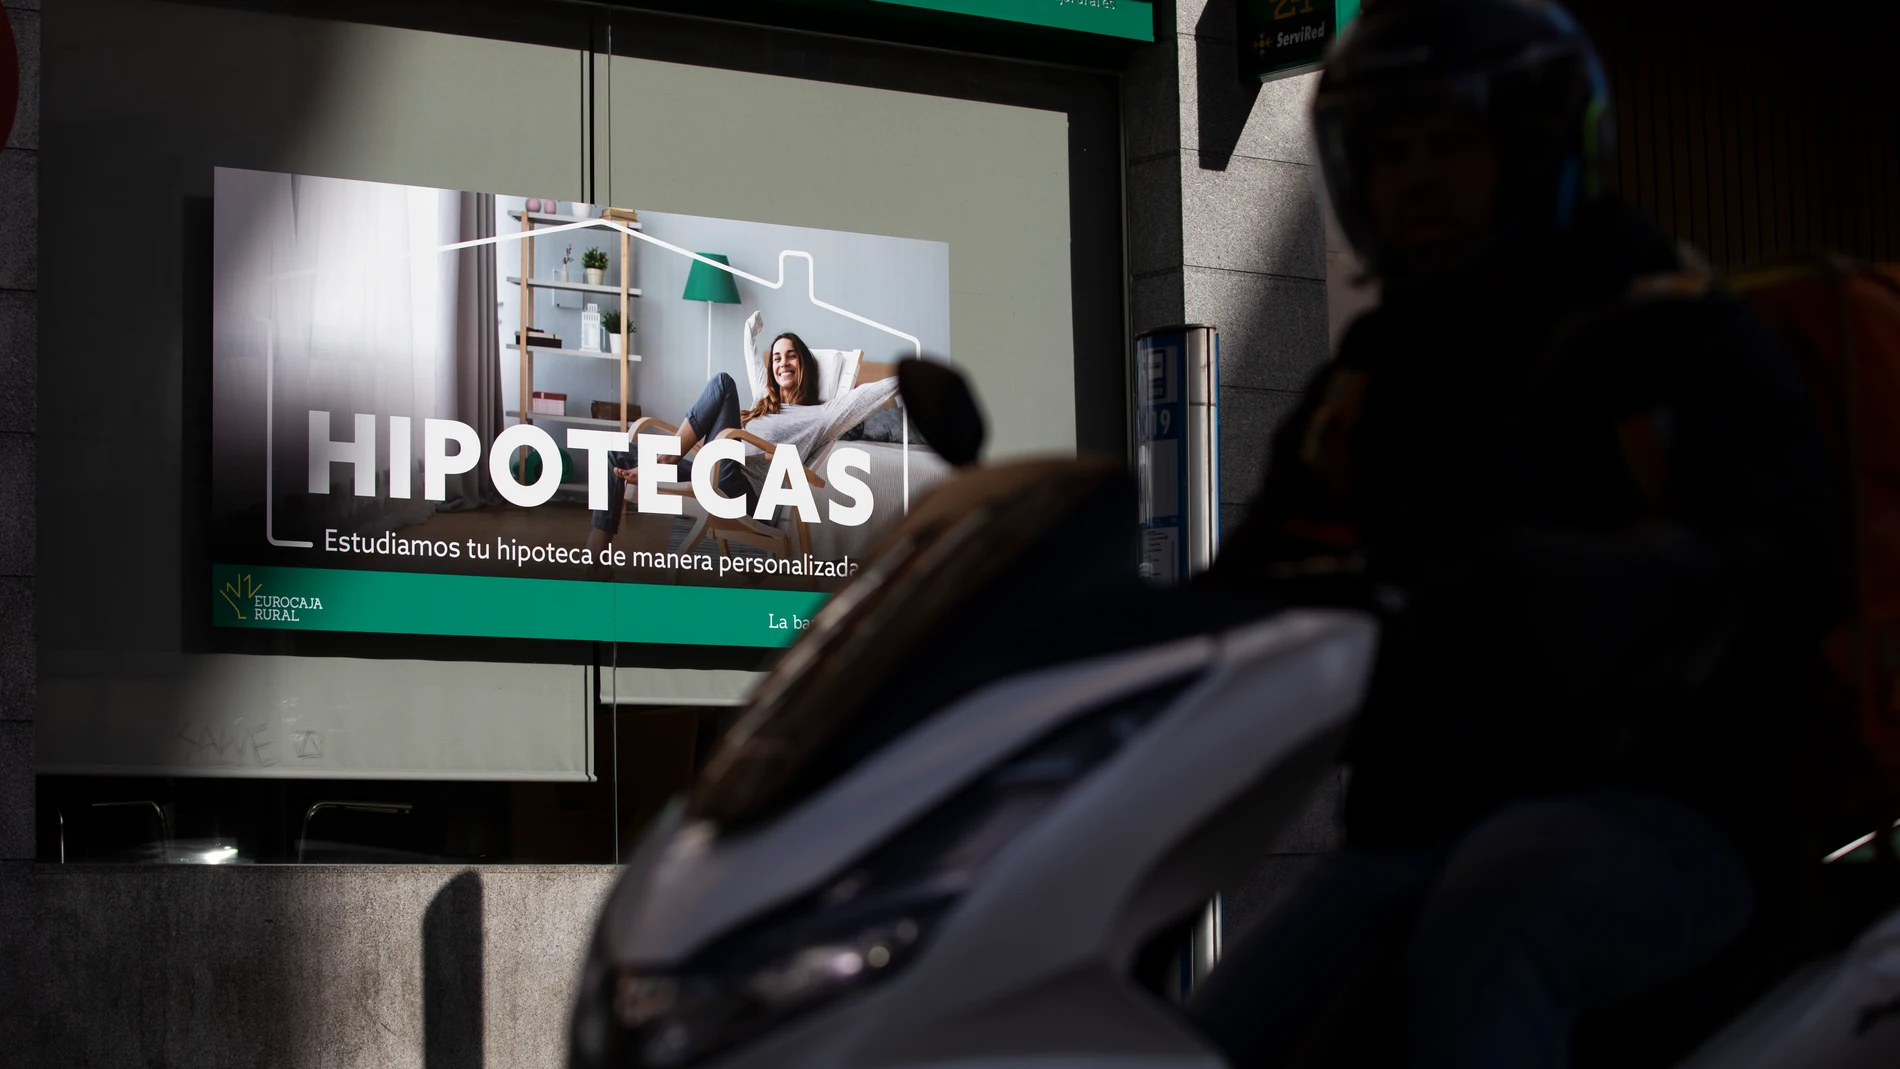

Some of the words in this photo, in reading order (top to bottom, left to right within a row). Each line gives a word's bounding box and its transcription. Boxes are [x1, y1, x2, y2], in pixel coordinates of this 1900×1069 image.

[1276, 21, 1325, 48] ServiRed
[308, 410, 874, 526] HIPOTECAS
[325, 528, 460, 558] Estudiamos
[466, 538, 490, 560] tu
[497, 536, 594, 568] hipoteca
[599, 543, 626, 567] de
[633, 550, 713, 572] manera
[254, 595, 324, 610] EUROCAJA
[254, 608, 300, 622] RURAL
[768, 613, 788, 629] La
